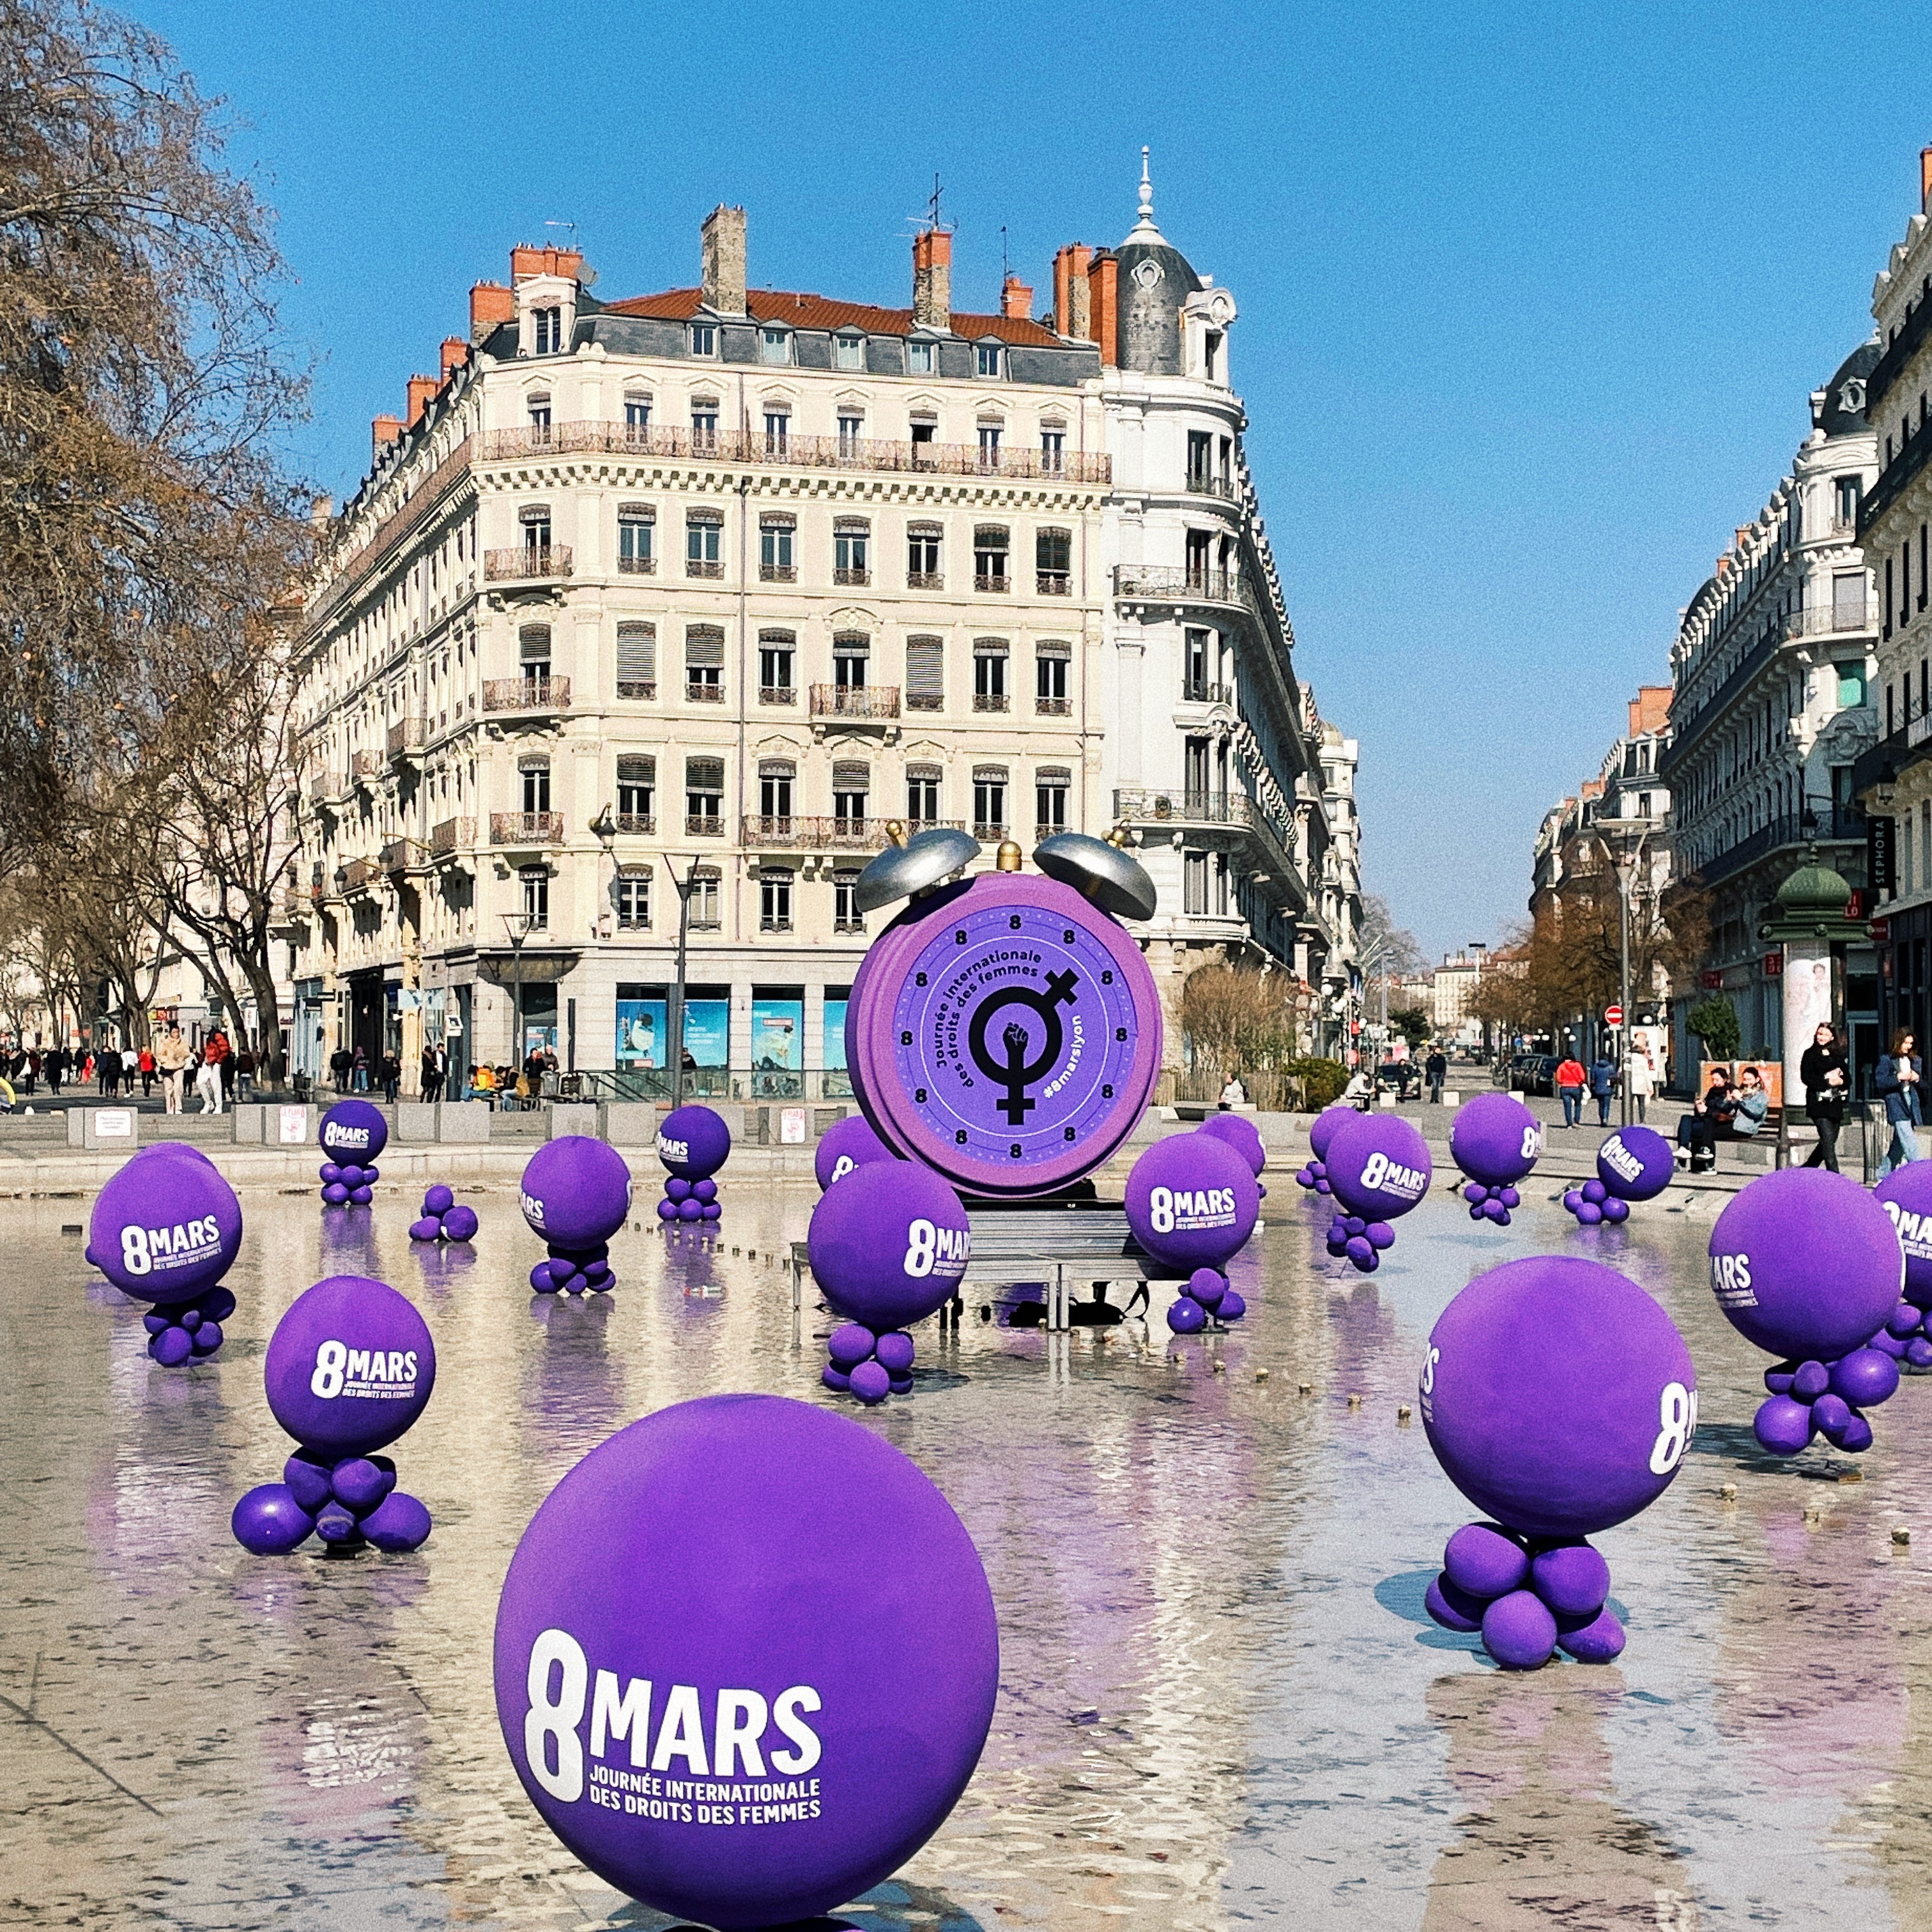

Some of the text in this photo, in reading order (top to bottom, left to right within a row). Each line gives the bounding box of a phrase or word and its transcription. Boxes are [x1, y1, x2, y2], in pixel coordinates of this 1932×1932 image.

[1875, 821, 1885, 884] SEPHORA
[1844, 906, 1859, 917] LO
[1009, 915, 1022, 930] 8
[955, 930, 967, 945] 8
[1063, 930, 1075, 944] 8
[916, 972, 928, 987] 8
[1101, 970, 1113, 985] 8
[935, 949, 1041, 1068] Journée internationale
[946, 964, 1038, 1087] des droits des femmes
[901, 1031, 913, 1046] 8
[1116, 1027, 1127, 1042] 8
[1043, 1015, 1085, 1099] #8marslyon
[915, 1088, 927, 1103] 8
[1101, 1084, 1114, 1098] 8
[955, 1130, 967, 1144] 8
[1064, 1127, 1076, 1142] 8
[1010, 1144, 1022, 1158] 8
[1897, 1210, 1932, 1245] MA
[935, 1227, 970, 1261] MAR
[1712, 1254, 1752, 1289] ARS
[1649, 1381, 1689, 1475] 8
[525, 1628, 822, 1803] 8 MARS
[589, 1764, 821, 1804] JOURNÉE INTERNATIONALE
[589, 1784, 822, 1826] DES DROITS DES FEMMES
